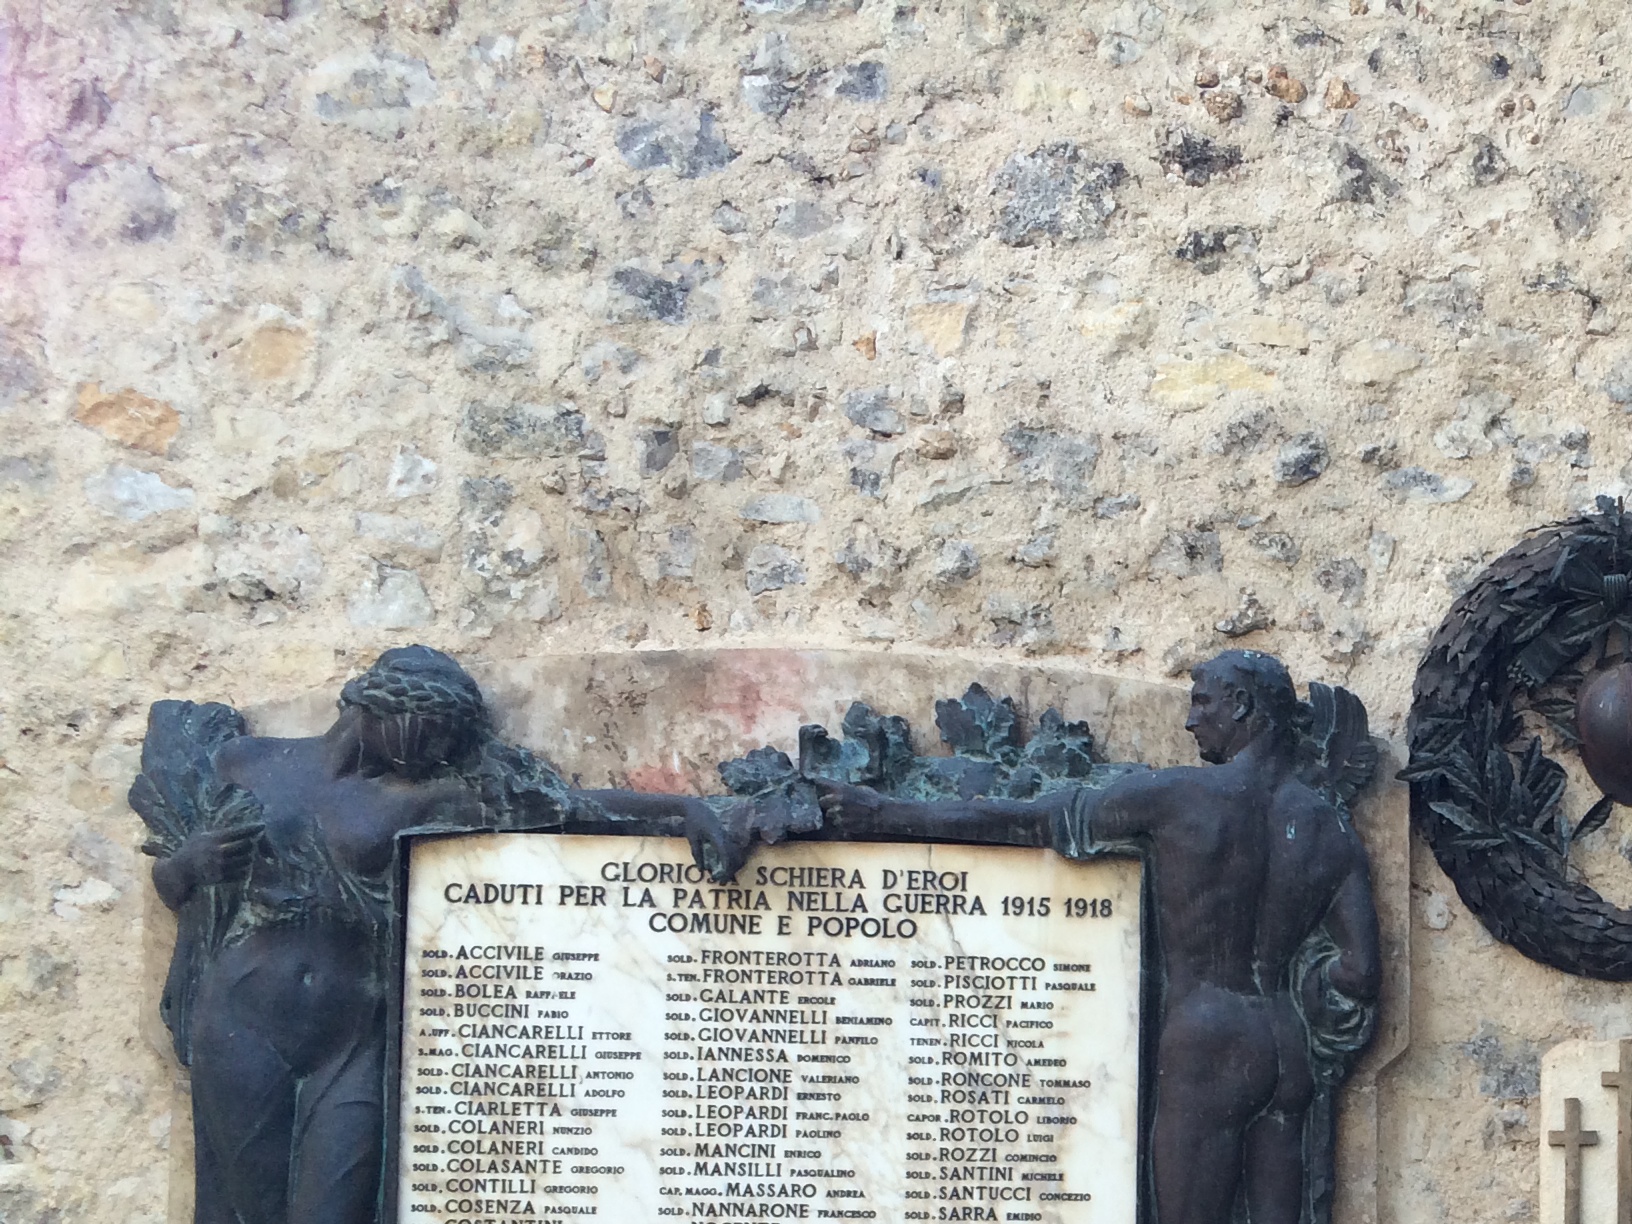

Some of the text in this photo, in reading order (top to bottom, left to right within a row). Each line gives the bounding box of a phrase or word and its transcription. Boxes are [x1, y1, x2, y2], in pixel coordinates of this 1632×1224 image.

[756, 867, 866, 889] SCHIERA
[882, 869, 968, 892] D'EROI
[444, 883, 1112, 918] CADUTI PER LA PATRIA NELLA GUERRA 1915 1918
[649, 912, 917, 938] COMUNE E POPOLO
[456, 945, 544, 962] ACCIVILE
[552, 953, 599, 961] GIUSEPPE
[701, 950, 841, 967] FRONTEROTTA
[850, 959, 895, 968] ADRIANO
[944, 975, 1037, 990] PISCIOTTI
[1045, 983, 1096, 991] PASQUALE
[700, 989, 789, 1004] GALANTE
[798, 997, 836, 1005] ERCOLE
[944, 994, 1012, 1009] PROZZI
[1021, 1002, 1054, 1010] MARIO
[454, 1004, 529, 1018] BUCCINI
[538, 1010, 569, 1018] FABIO
[942, 1052, 1018, 1066] ROMITO
[1026, 1059, 1067, 1067] AMEDEO
[450, 1081, 575, 1097] CIANCARELLI
[584, 1089, 625, 1098] ADOLFO
[940, 1128, 1019, 1142] ROTOLO
[1027, 1134, 1054, 1142] LUIGI
[694, 1143, 775, 1158] MANCINI
[784, 1150, 821, 1158] ENRICO
